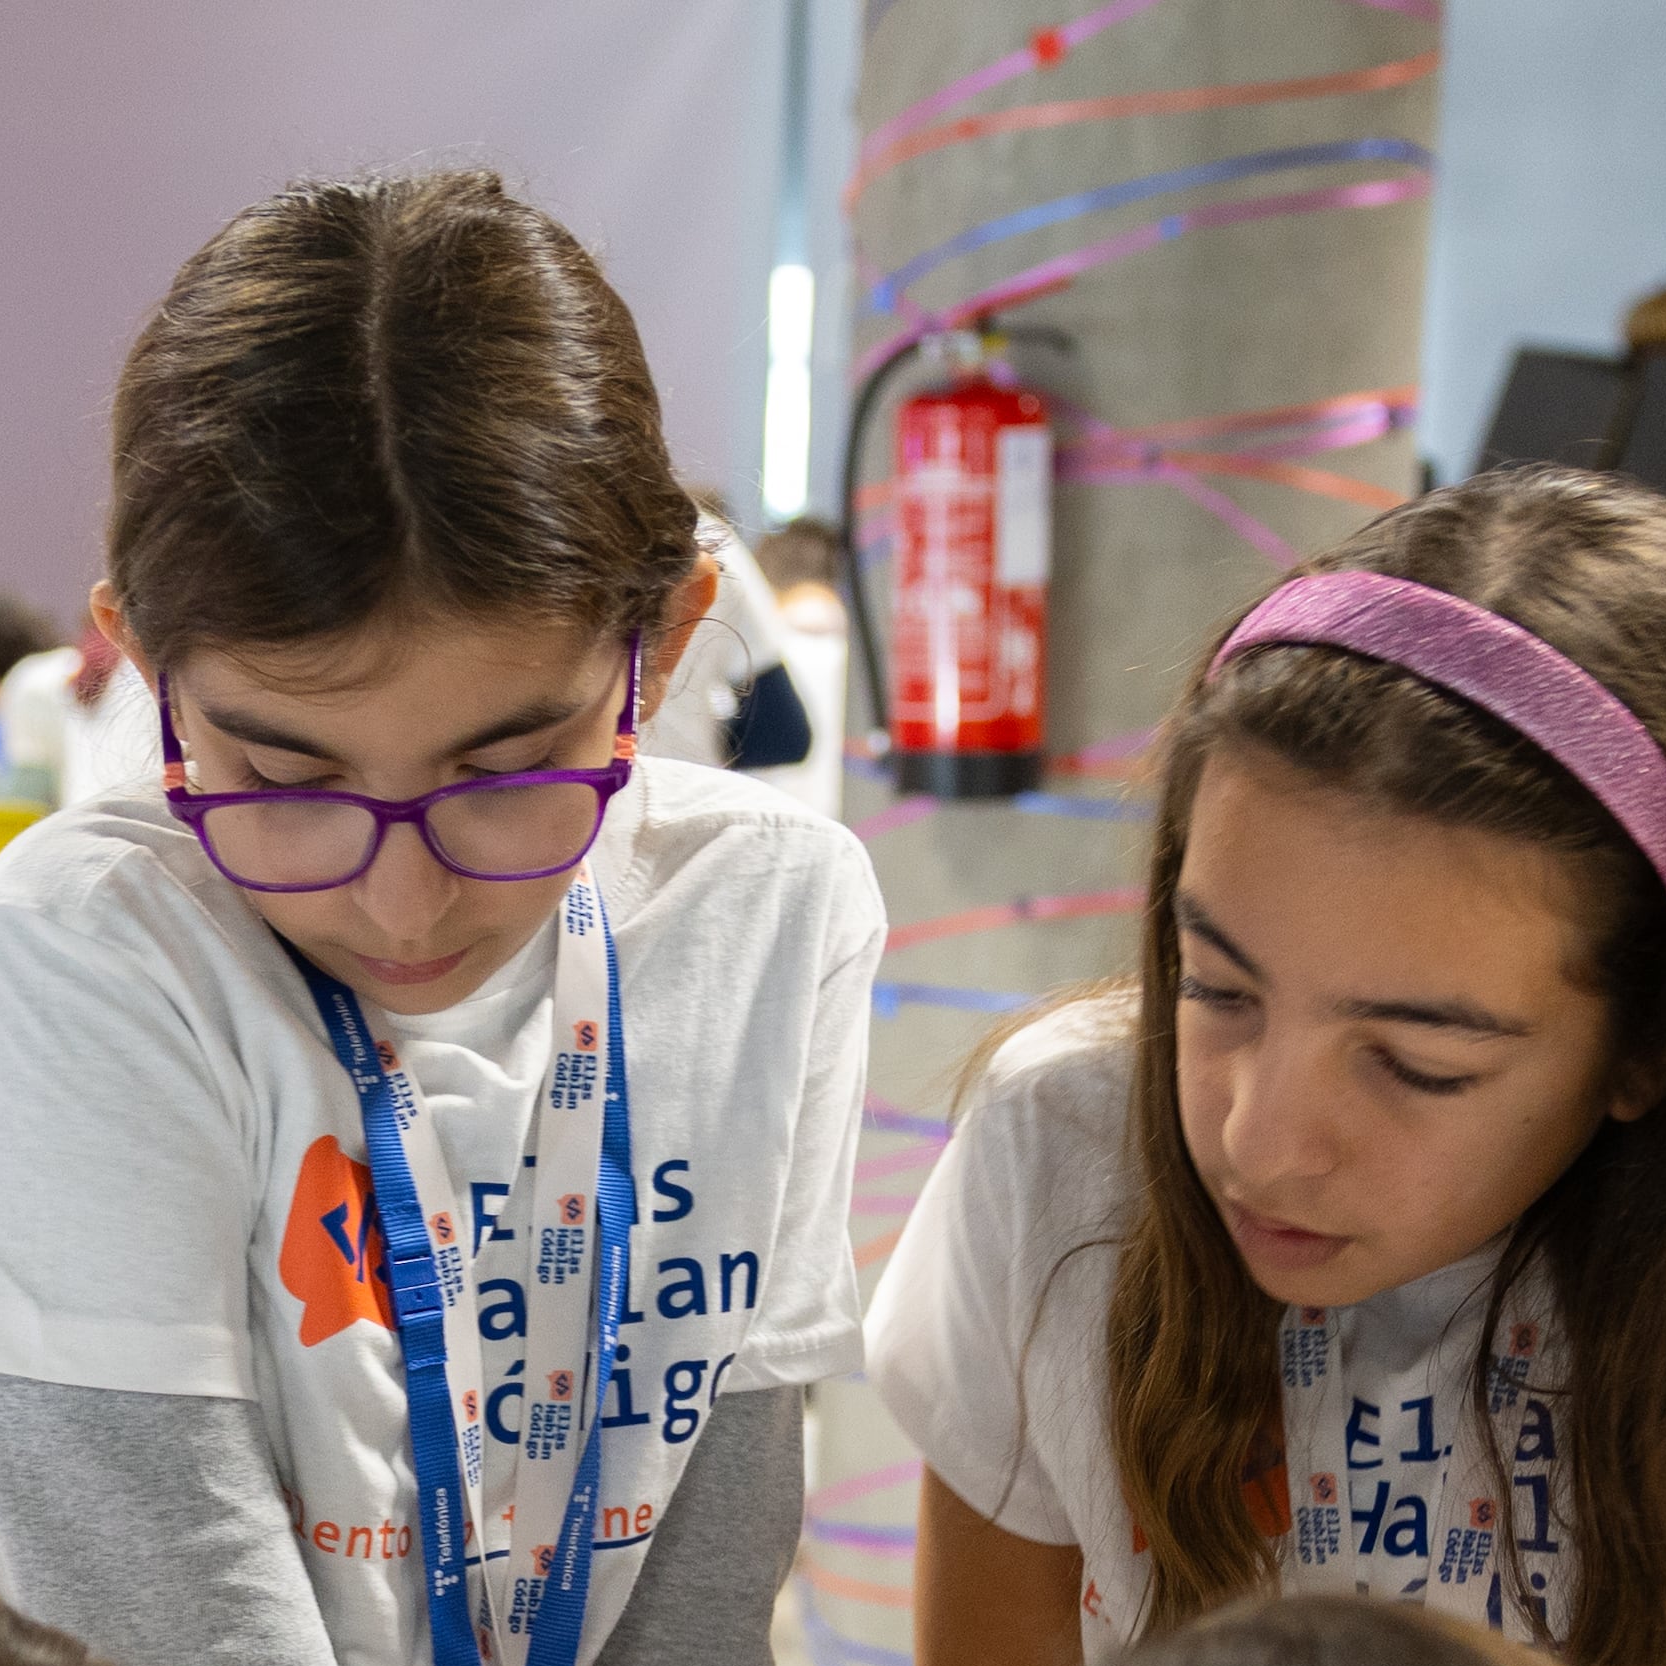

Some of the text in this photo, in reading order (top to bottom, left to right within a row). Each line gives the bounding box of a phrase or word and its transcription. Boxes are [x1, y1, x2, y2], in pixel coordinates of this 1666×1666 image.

[550, 1052, 569, 1109] Código
[567, 1053, 584, 1110] Hablan
[582, 1054, 597, 1100] Ellas
[536, 1227, 555, 1285] Código
[554, 1227, 570, 1285] Hablan
[569, 1228, 584, 1275] Ellas
[525, 1402, 544, 1460] Código
[540, 1403, 558, 1461] Hablan
[555, 1404, 571, 1451] Ellas
[435, 1487, 452, 1566] Telefónica
[561, 1517, 582, 1592] Telefónica
[1472, 1531, 1493, 1576] Ellas
[1438, 1527, 1462, 1584] Código
[507, 1578, 528, 1635] Código
